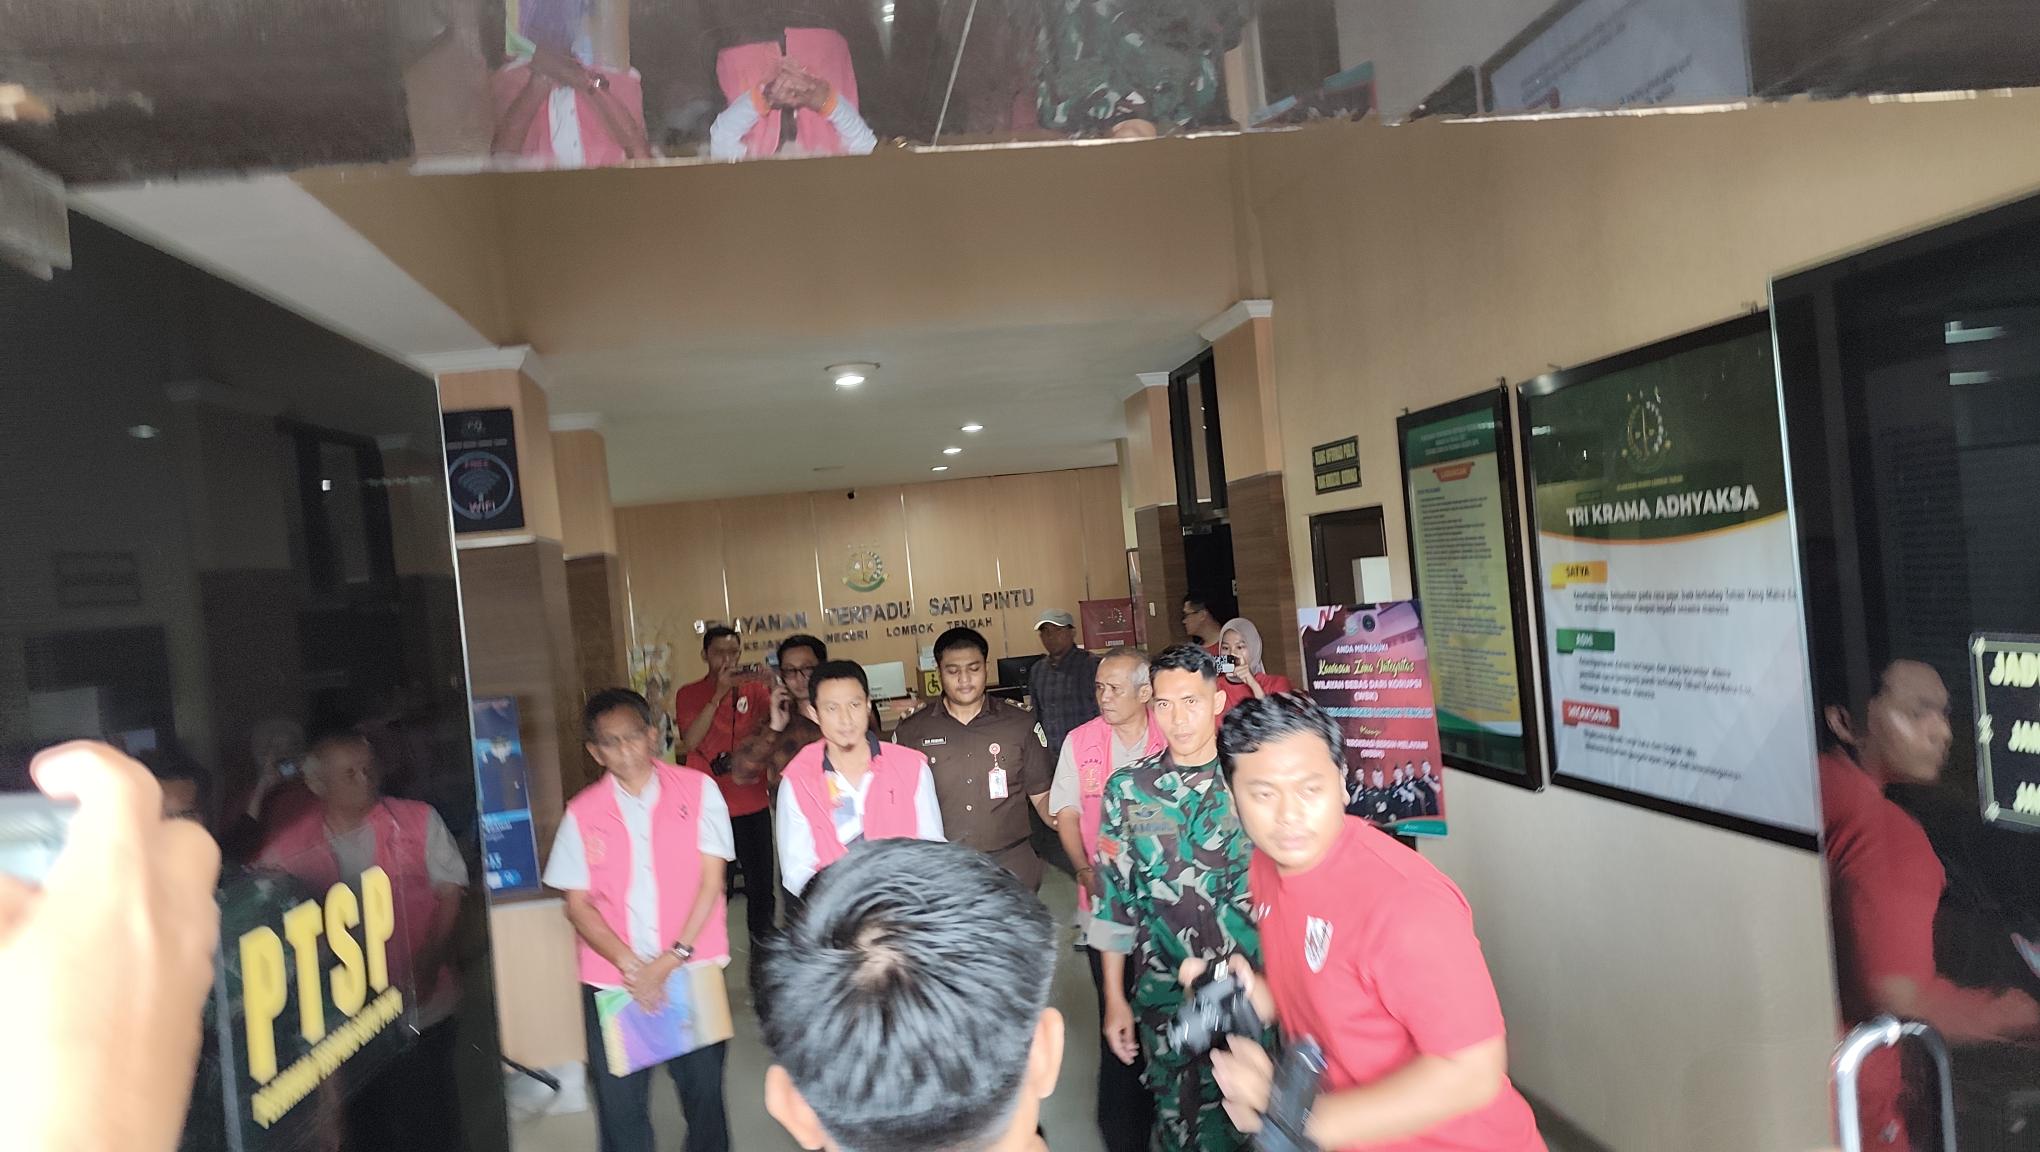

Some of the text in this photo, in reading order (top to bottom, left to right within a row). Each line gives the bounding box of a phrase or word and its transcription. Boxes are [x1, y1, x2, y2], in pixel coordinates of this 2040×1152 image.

[1566, 484, 1760, 527] TRI KRAMA ADHYAKSA
[824, 600, 911, 627] TERPADU
[928, 593, 974, 617] SATU
[981, 588, 1036, 611] PINTU
[886, 622, 935, 638] LOMBOK
[946, 616, 994, 631] TENGAH
[239, 864, 396, 1087] PTSP
